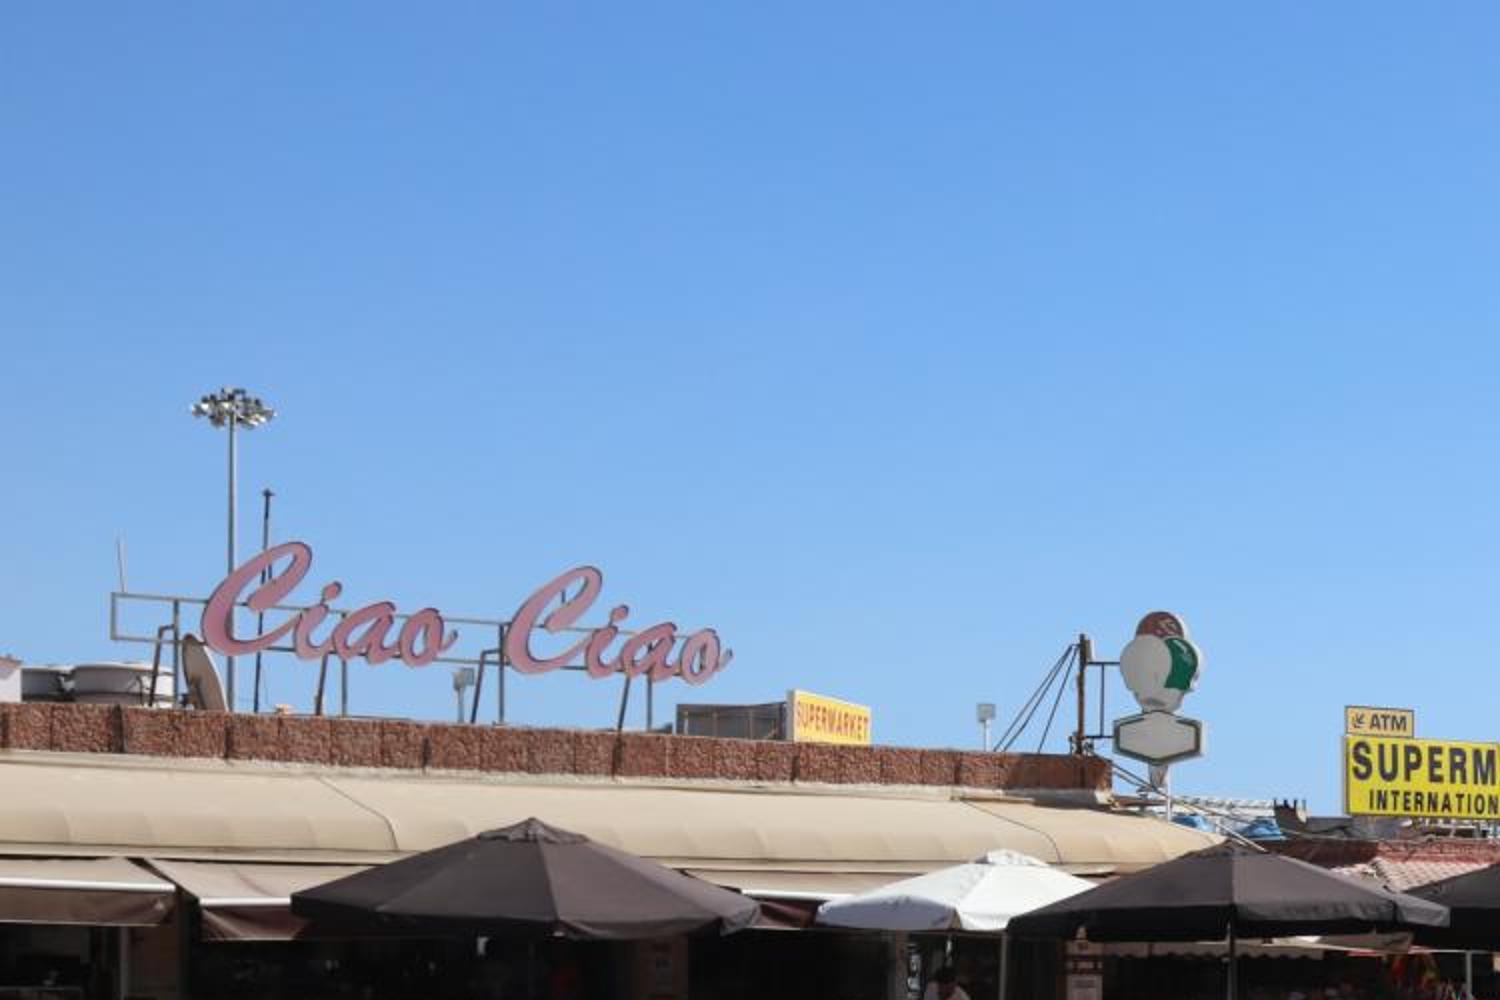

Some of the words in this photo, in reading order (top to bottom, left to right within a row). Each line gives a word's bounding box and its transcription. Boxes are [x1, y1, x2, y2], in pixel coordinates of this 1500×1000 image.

[201, 541, 457, 667] Ciao
[505, 565, 733, 685] Ciao
[795, 700, 869, 741] SUPERMARKET
[1369, 714, 1408, 732] ATM
